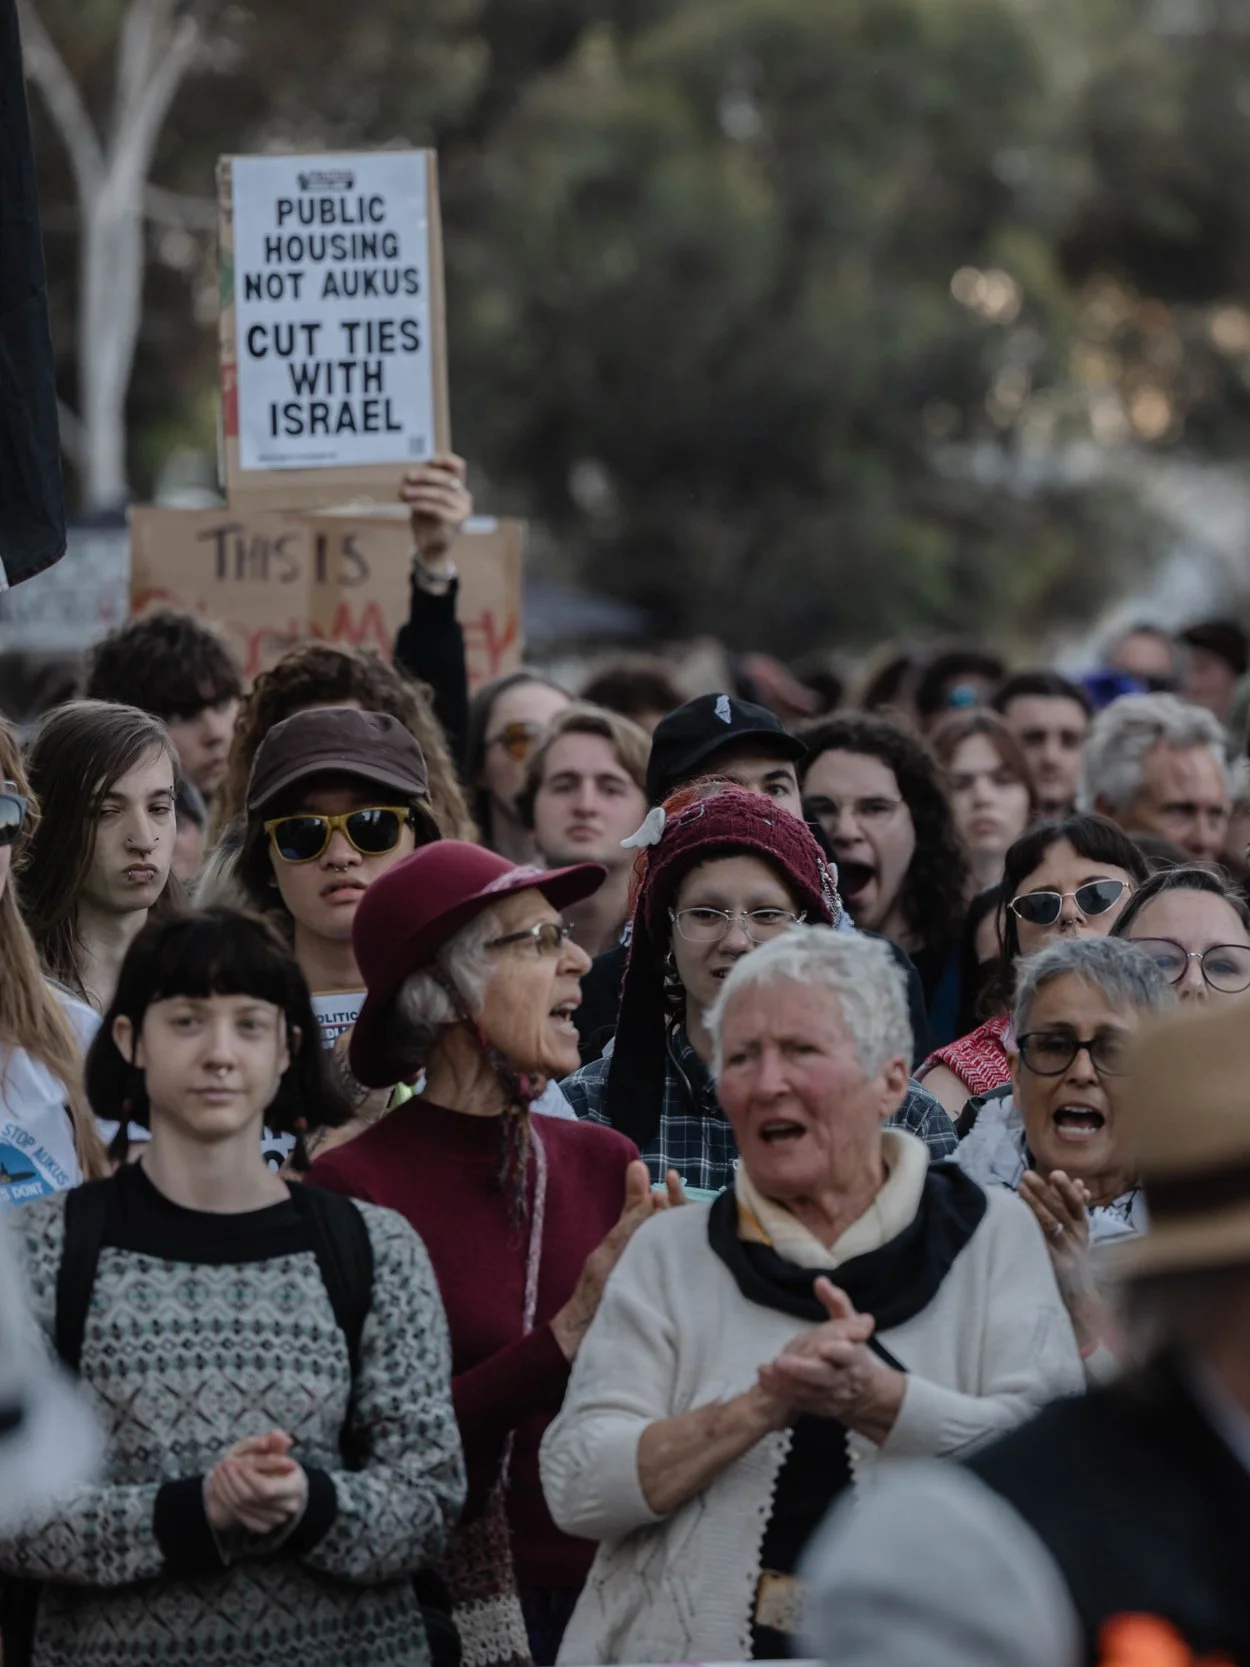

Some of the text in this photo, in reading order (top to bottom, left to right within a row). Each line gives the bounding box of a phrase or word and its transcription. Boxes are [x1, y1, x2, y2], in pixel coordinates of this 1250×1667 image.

[276, 195, 385, 227] PUBLIC
[264, 232, 399, 264] HOUSING
[244, 268, 420, 300] NOT AUKUS
[247, 319, 420, 358] CUT TIES
[289, 361, 384, 396] WITH
[270, 399, 402, 437] ISRAEL
[197, 521, 370, 588] THIS IS
[2, 1122, 36, 1148] STOP
